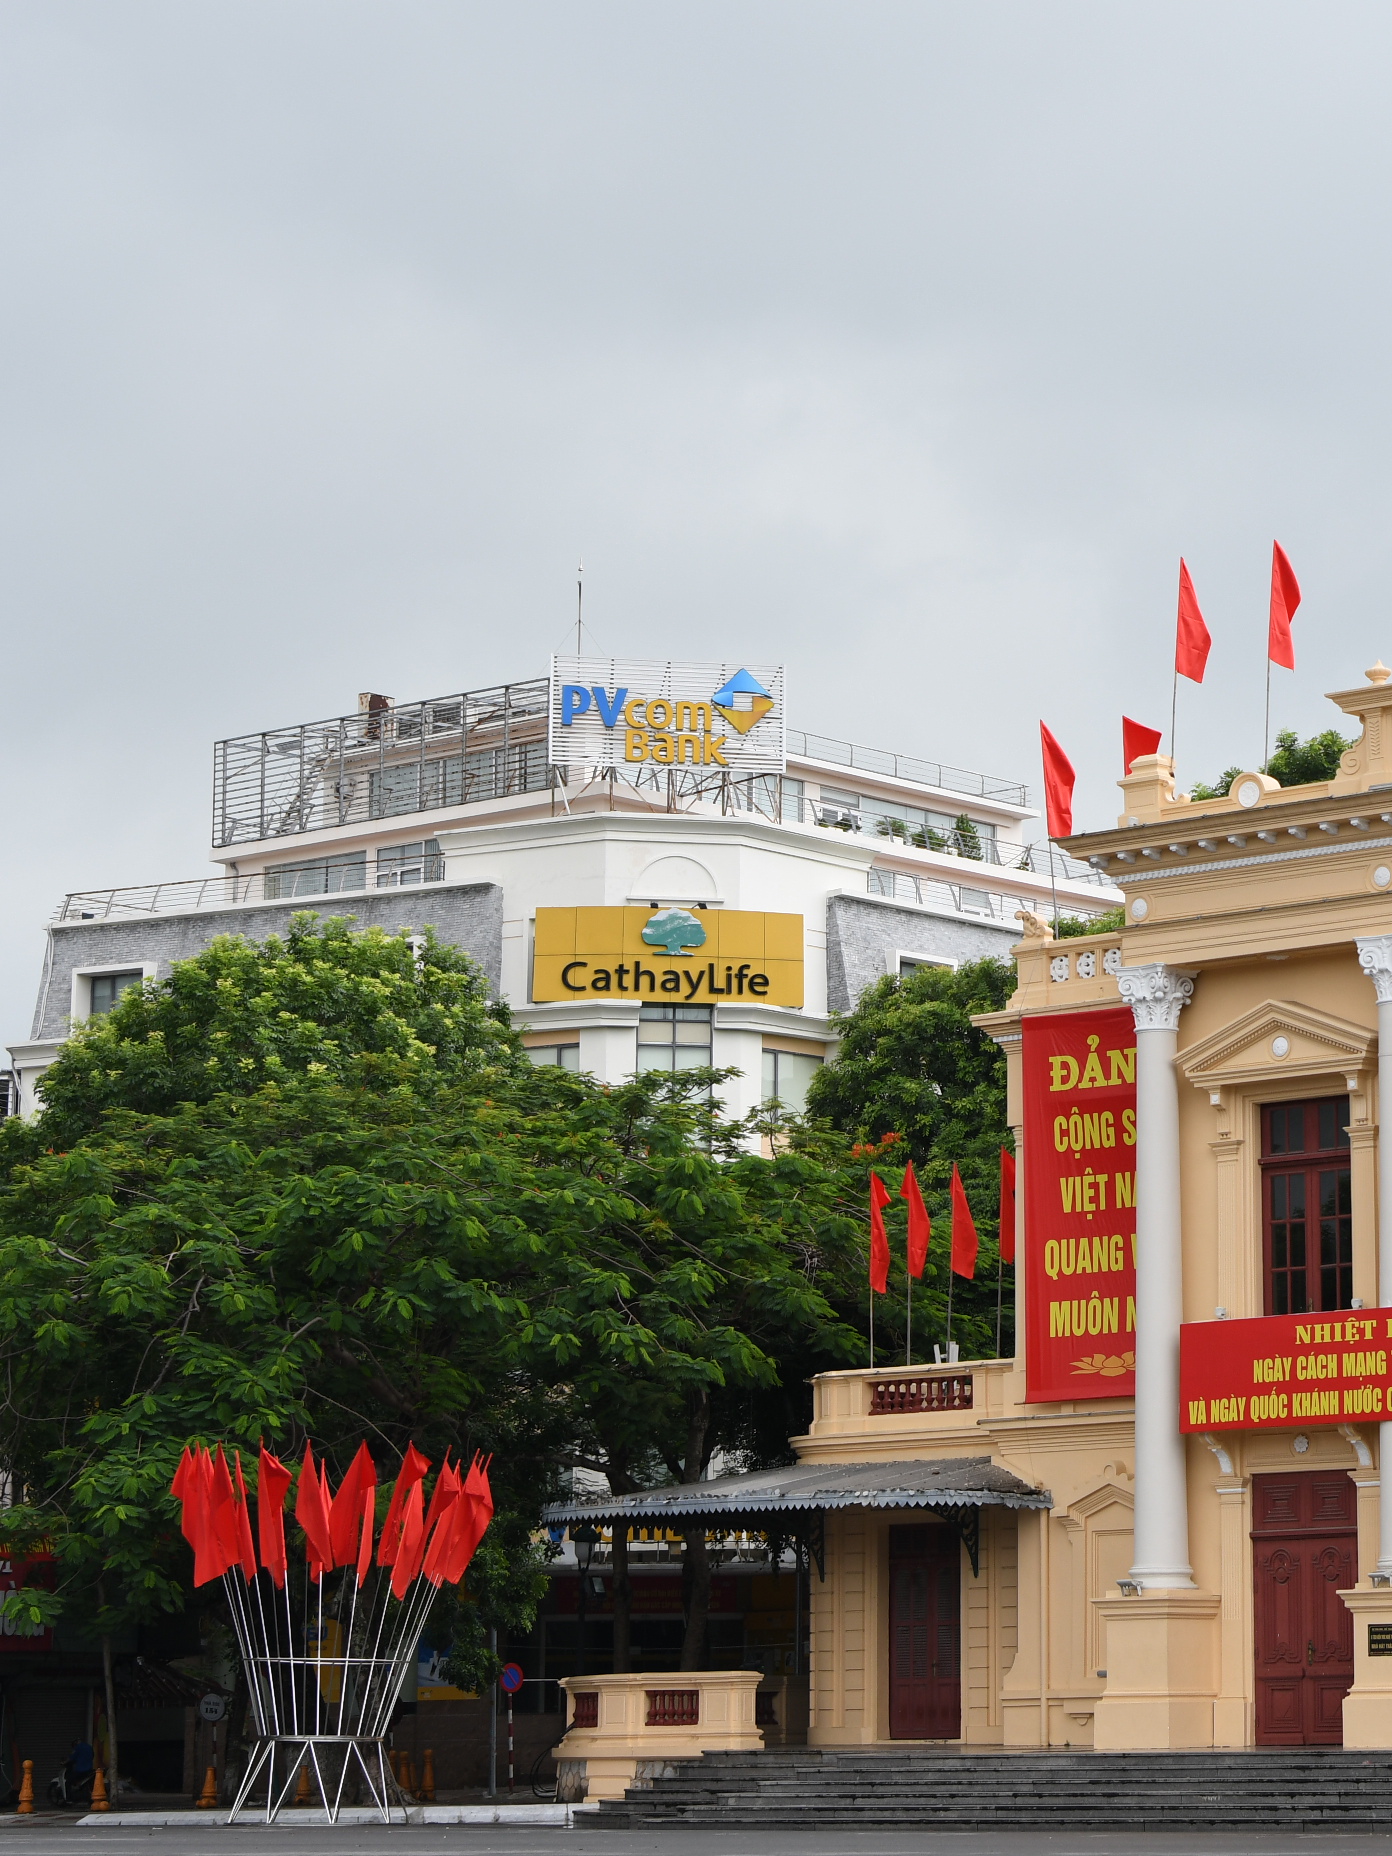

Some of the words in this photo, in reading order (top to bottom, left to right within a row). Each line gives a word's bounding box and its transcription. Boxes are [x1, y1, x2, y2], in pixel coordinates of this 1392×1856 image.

[625, 729, 729, 765] Bank
[1049, 1035, 1138, 1091] ĐẢN
[1054, 1107, 1115, 1159] CỘNG
[1060, 1168, 1108, 1219] VIỆT
[1045, 1235, 1123, 1280] QUANG
[1050, 1291, 1118, 1337] MUÔN
[1296, 1317, 1376, 1344] NHIỆT
[1254, 1354, 1292, 1383] NGÀY
[1297, 1352, 1337, 1380] CÁCH
[1343, 1350, 1386, 1380] MẠNG
[1189, 1397, 1206, 1424] VÀ
[1211, 1394, 1246, 1423] NGÀY
[1250, 1387, 1287, 1422] QUỐC
[1293, 1388, 1339, 1417] KHÁNH
[1344, 1385, 1382, 1414] NƯỚC
